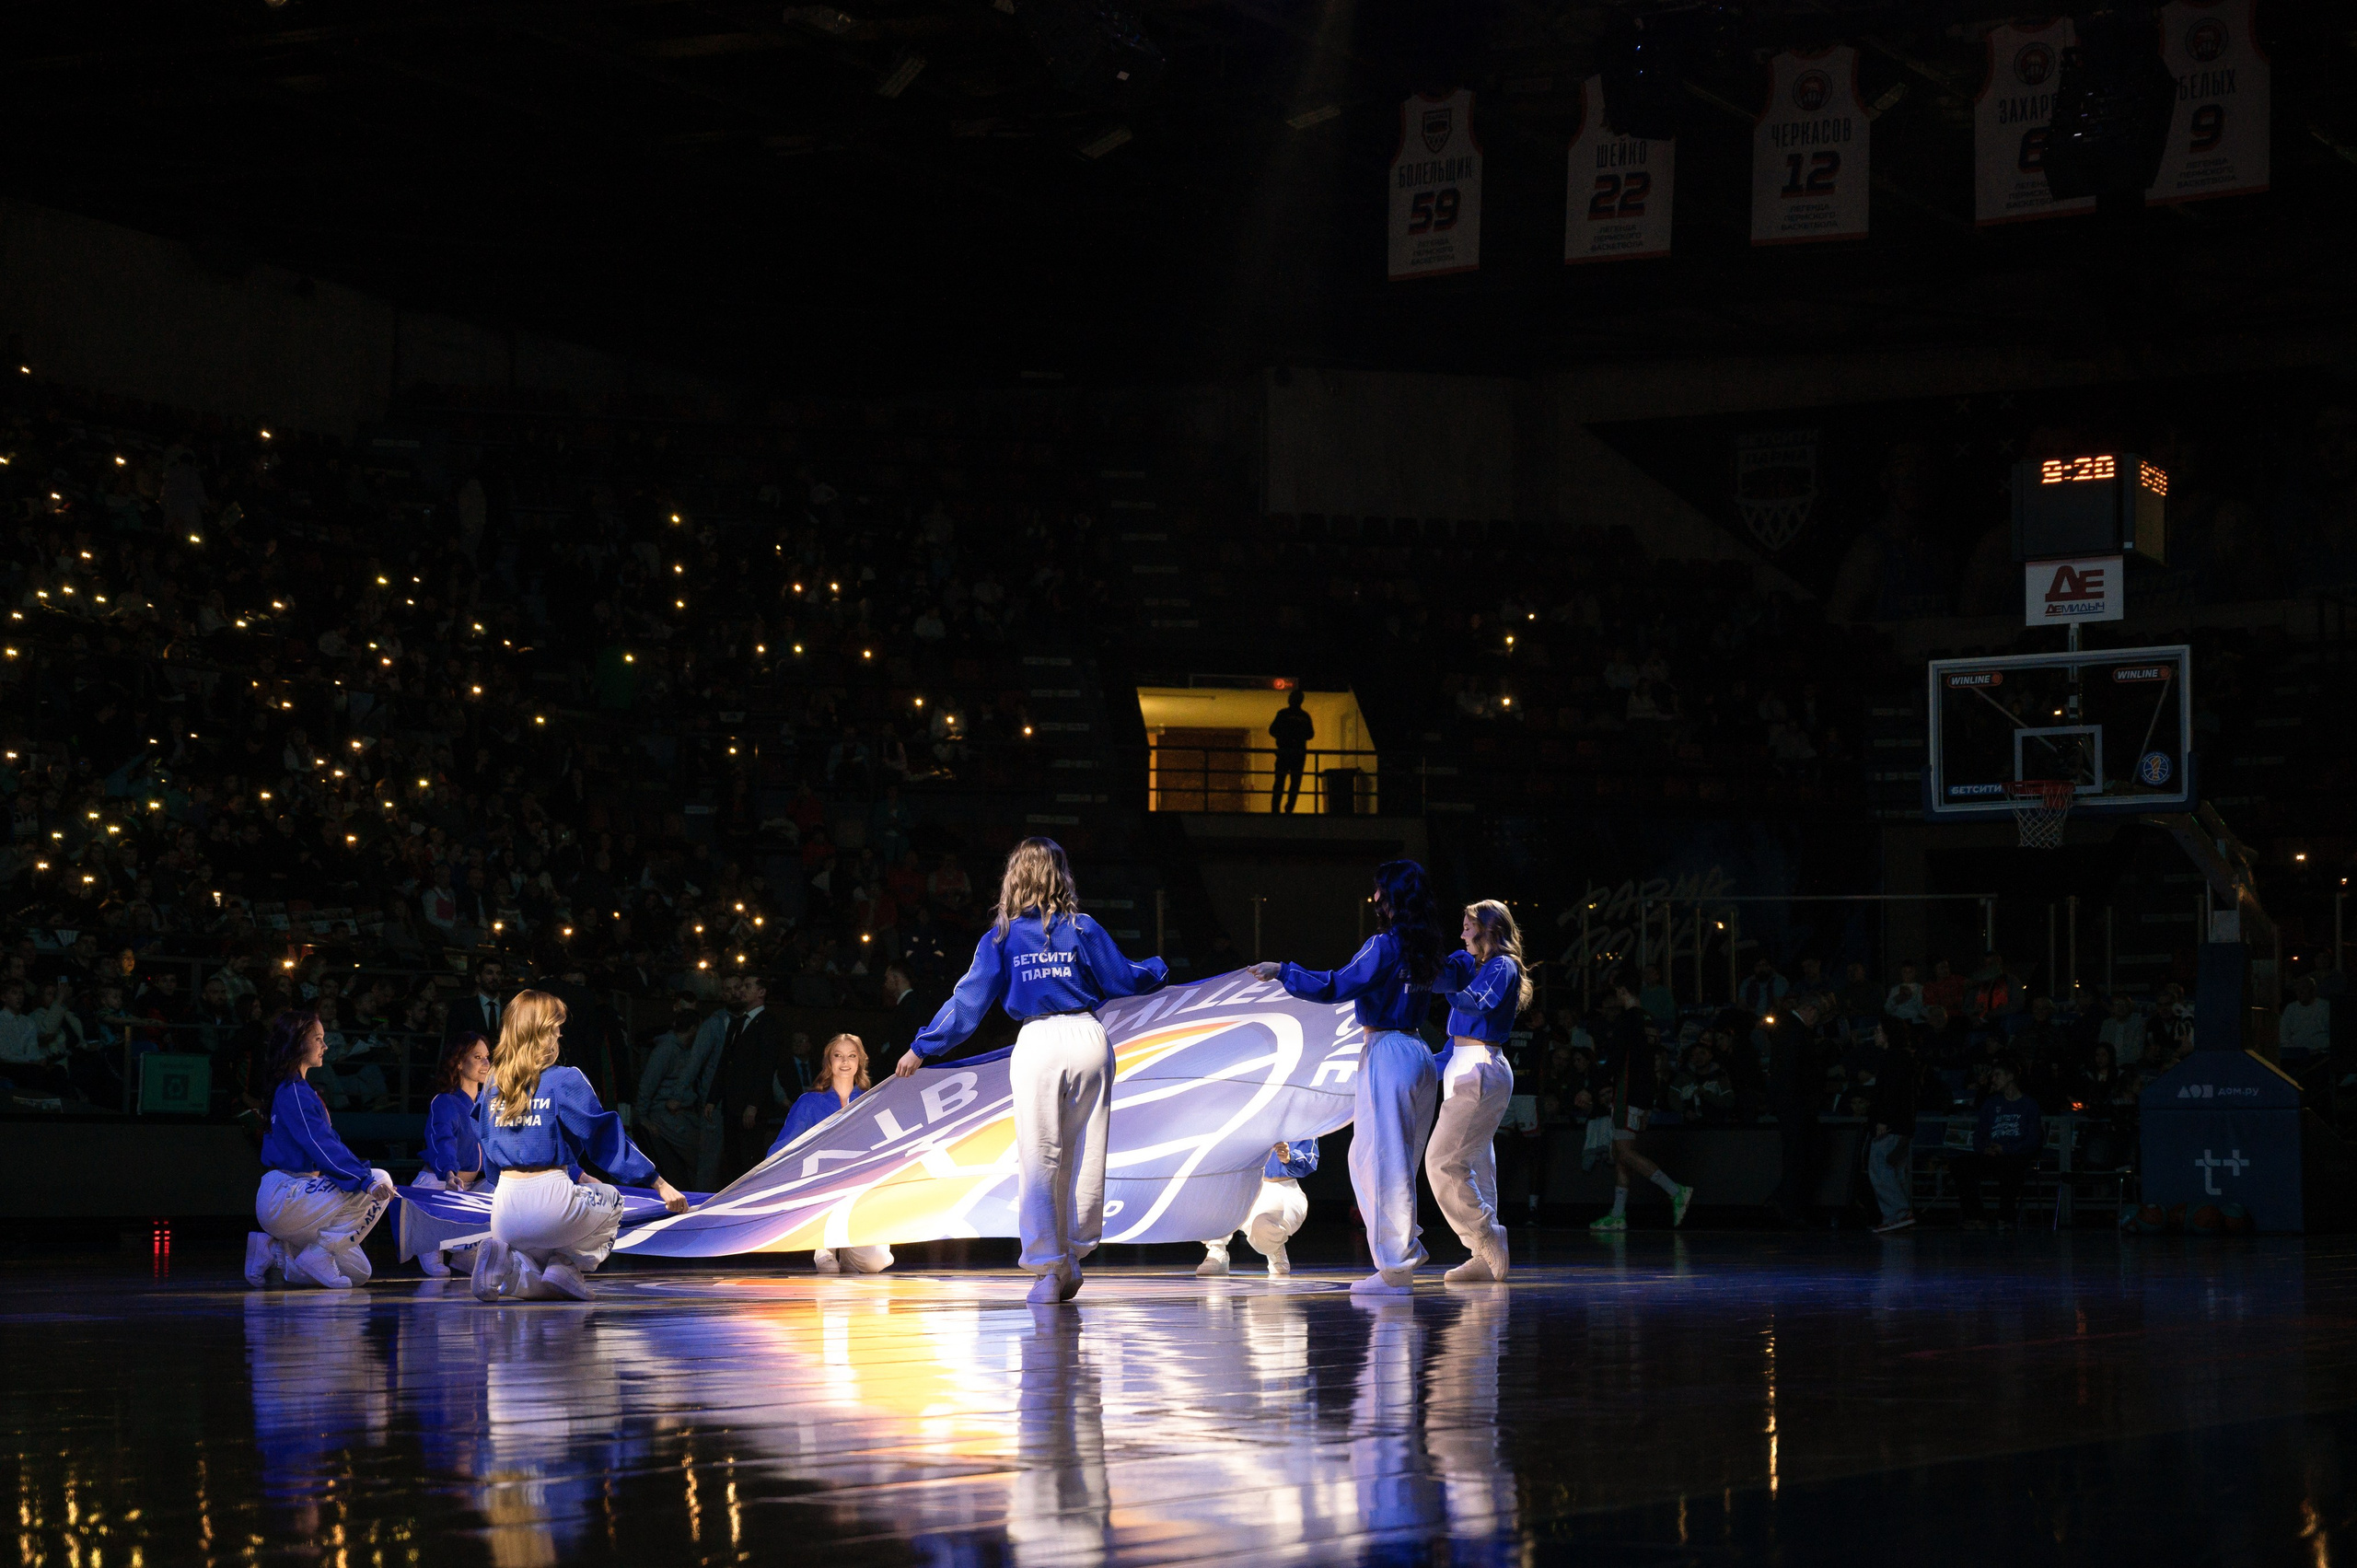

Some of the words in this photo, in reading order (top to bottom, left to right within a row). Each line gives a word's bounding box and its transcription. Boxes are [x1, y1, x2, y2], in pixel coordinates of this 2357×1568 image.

[2178, 69, 2236, 101] БЕЛЫХ
[1999, 94, 2058, 123] ЗАХАР
[1771, 118, 1852, 147] ЧЕРКАСОВ
[2189, 104, 2225, 154] 9
[1596, 137, 1648, 168] ШЕЙКО
[1399, 157, 1473, 188] БОЛЕЛЬЩИК
[1781, 150, 1840, 199] 12
[1587, 171, 1651, 221] 22
[1408, 188, 1460, 236] 59
[1950, 674, 1991, 686] WINLINE
[2117, 668, 2159, 680] WINLINE
[1951, 784, 2003, 796] БЕТСИТИ
[1013, 951, 1077, 968] БЕТСИТИ
[1021, 966, 1072, 982] ПАРМА
